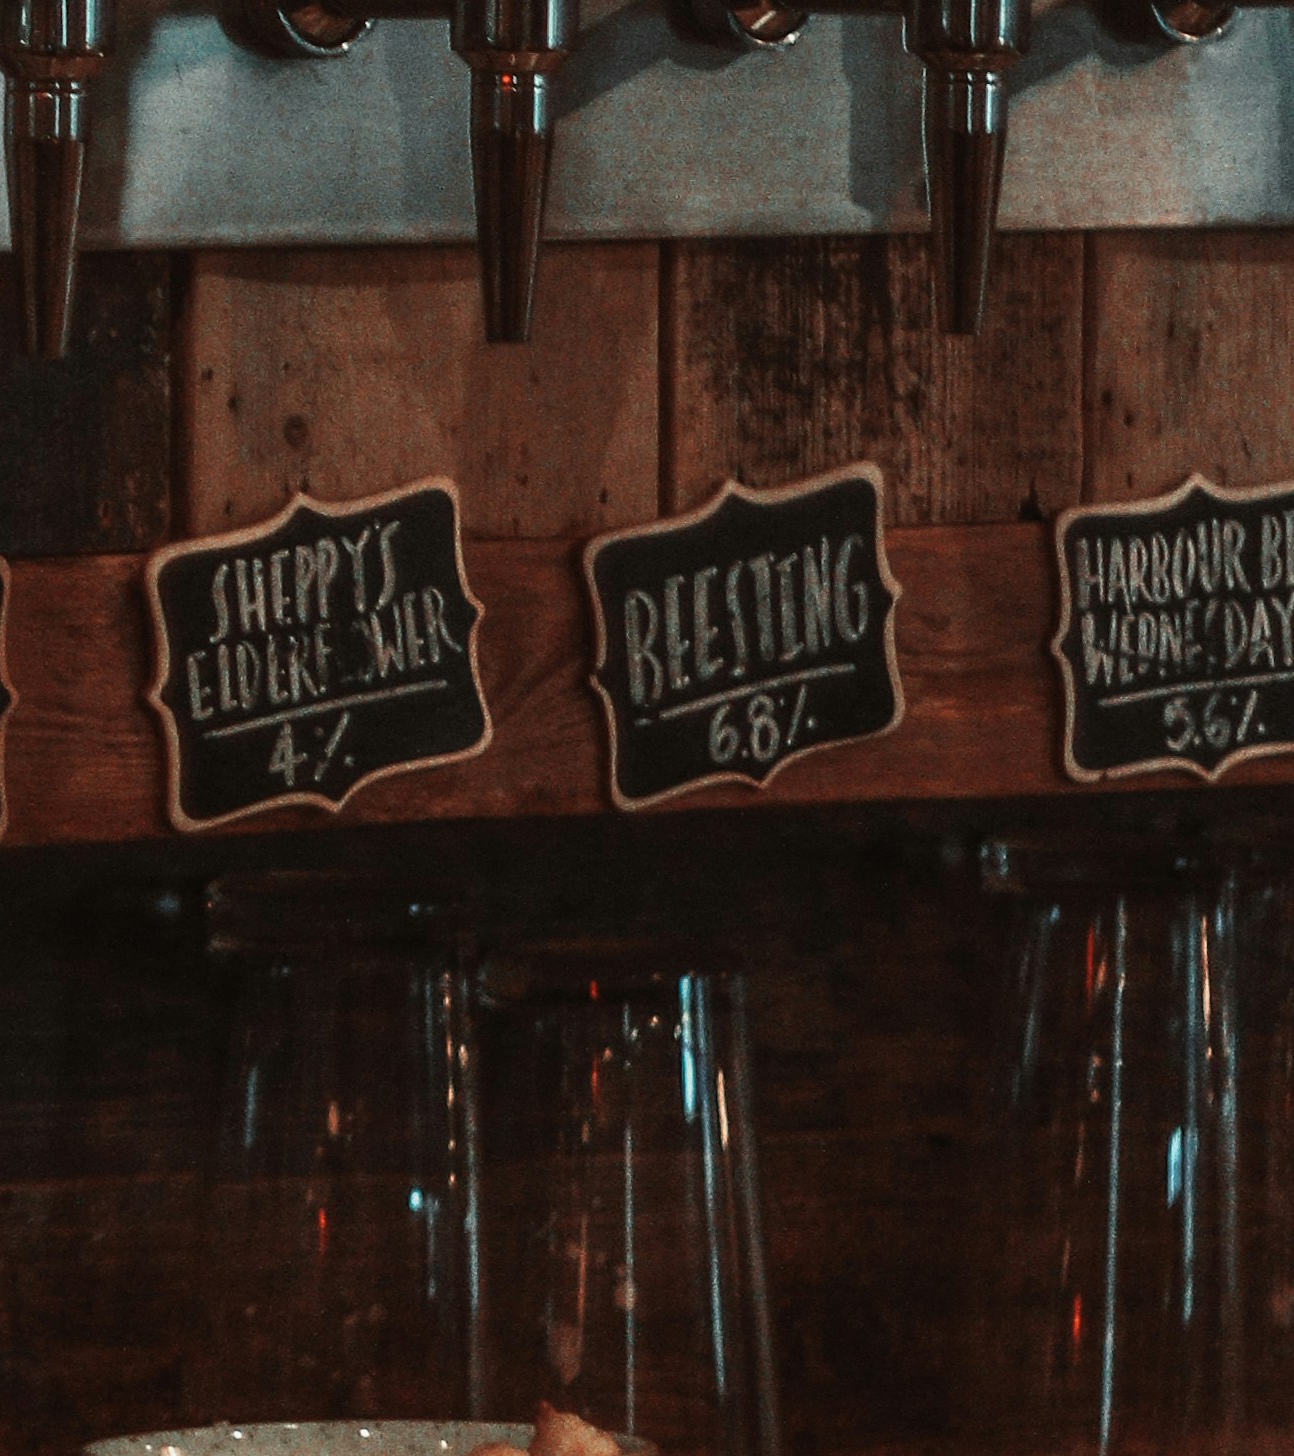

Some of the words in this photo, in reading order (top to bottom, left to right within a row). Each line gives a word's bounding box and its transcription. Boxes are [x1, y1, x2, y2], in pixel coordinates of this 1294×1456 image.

[209, 519, 400, 644] SHEPPY'S
[624, 533, 869, 706] BEESTING
[1075, 515, 1251, 614] HARBOUR
[187, 585, 463, 720] ELDERFWER
[708, 684, 819, 764] 6.8%
